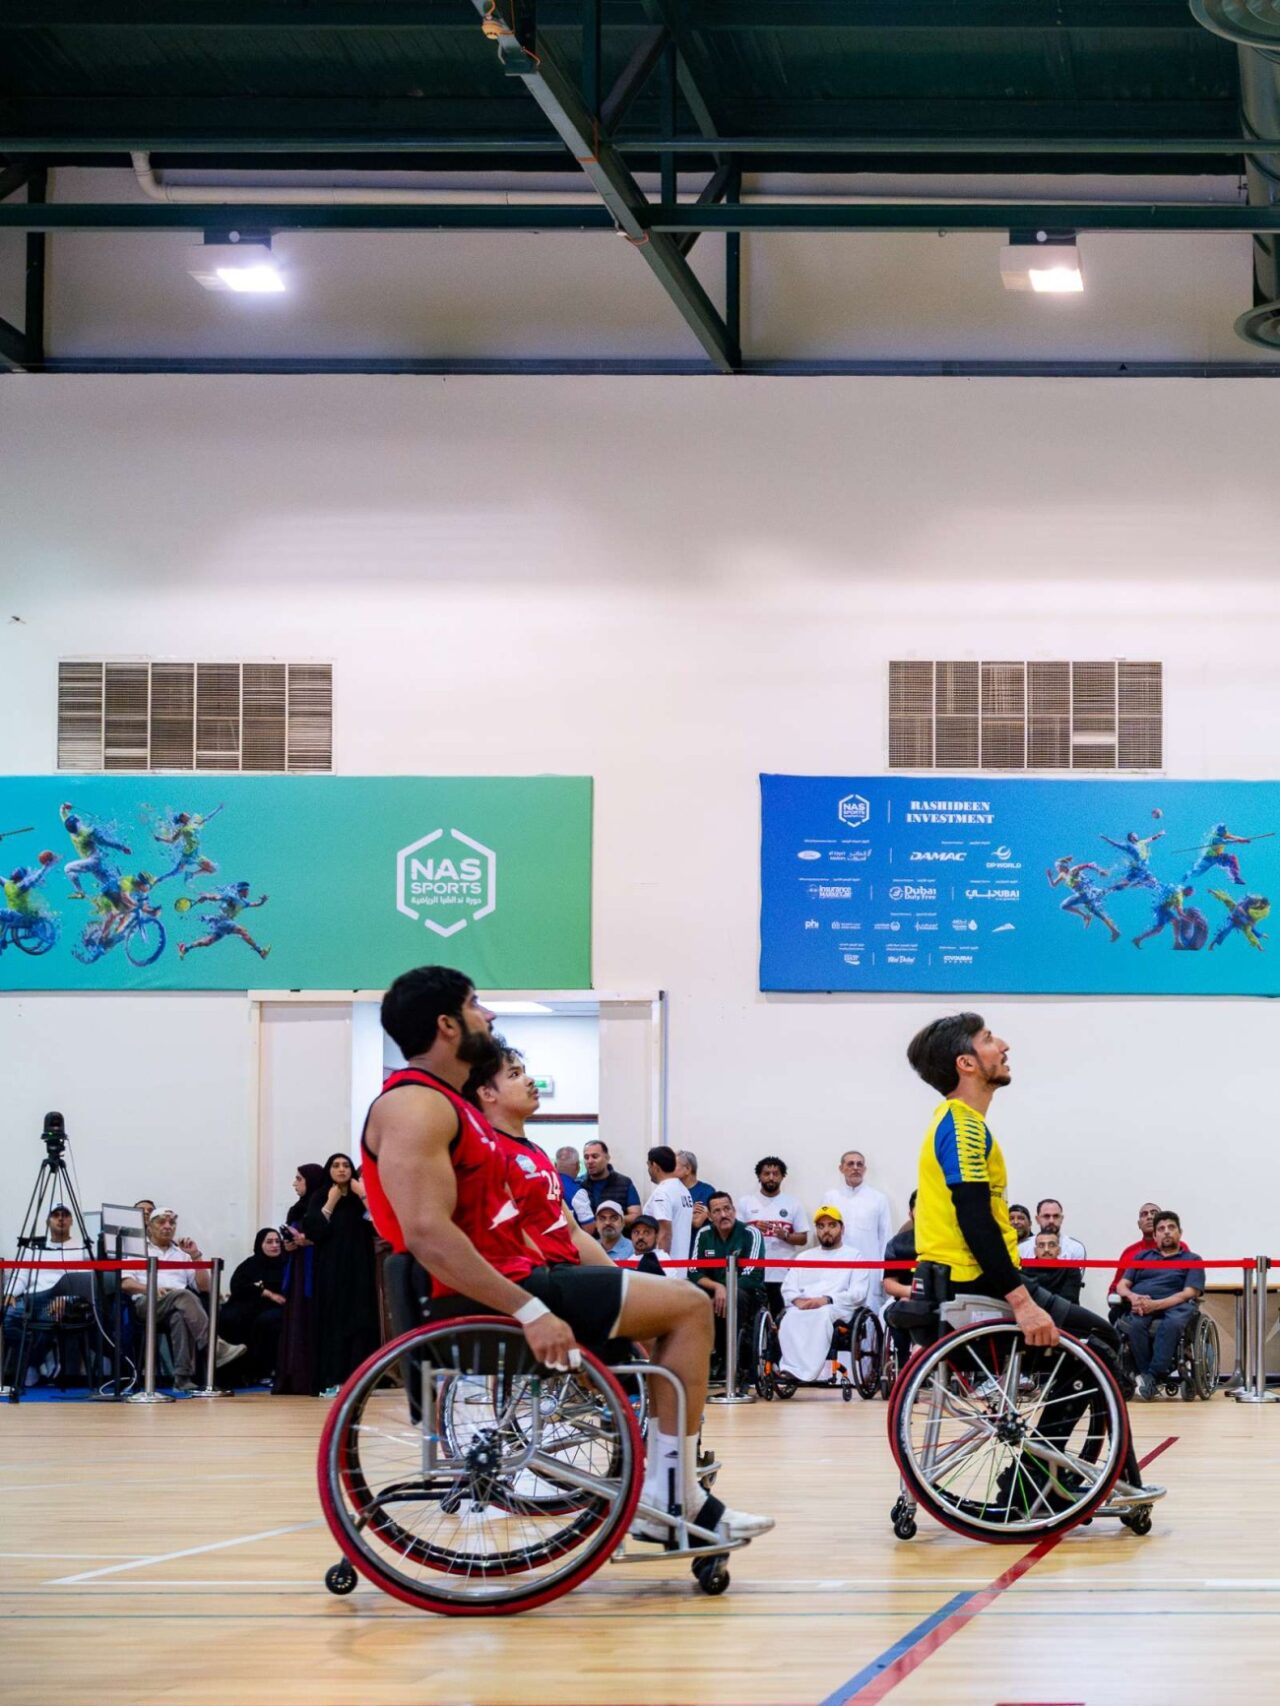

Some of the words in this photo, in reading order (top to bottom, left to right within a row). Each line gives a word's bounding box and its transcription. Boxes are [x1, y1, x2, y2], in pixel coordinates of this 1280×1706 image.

[843, 803, 865, 811] NAS
[910, 801, 991, 811] RASHIDEEN
[906, 813, 995, 824] INVESTMENT
[910, 851, 967, 861] DAMAC
[411, 858, 482, 881] NAS
[411, 882, 482, 894] SPORTS
[904, 886, 936, 896] Dubai
[541, 1170, 561, 1201] 24
